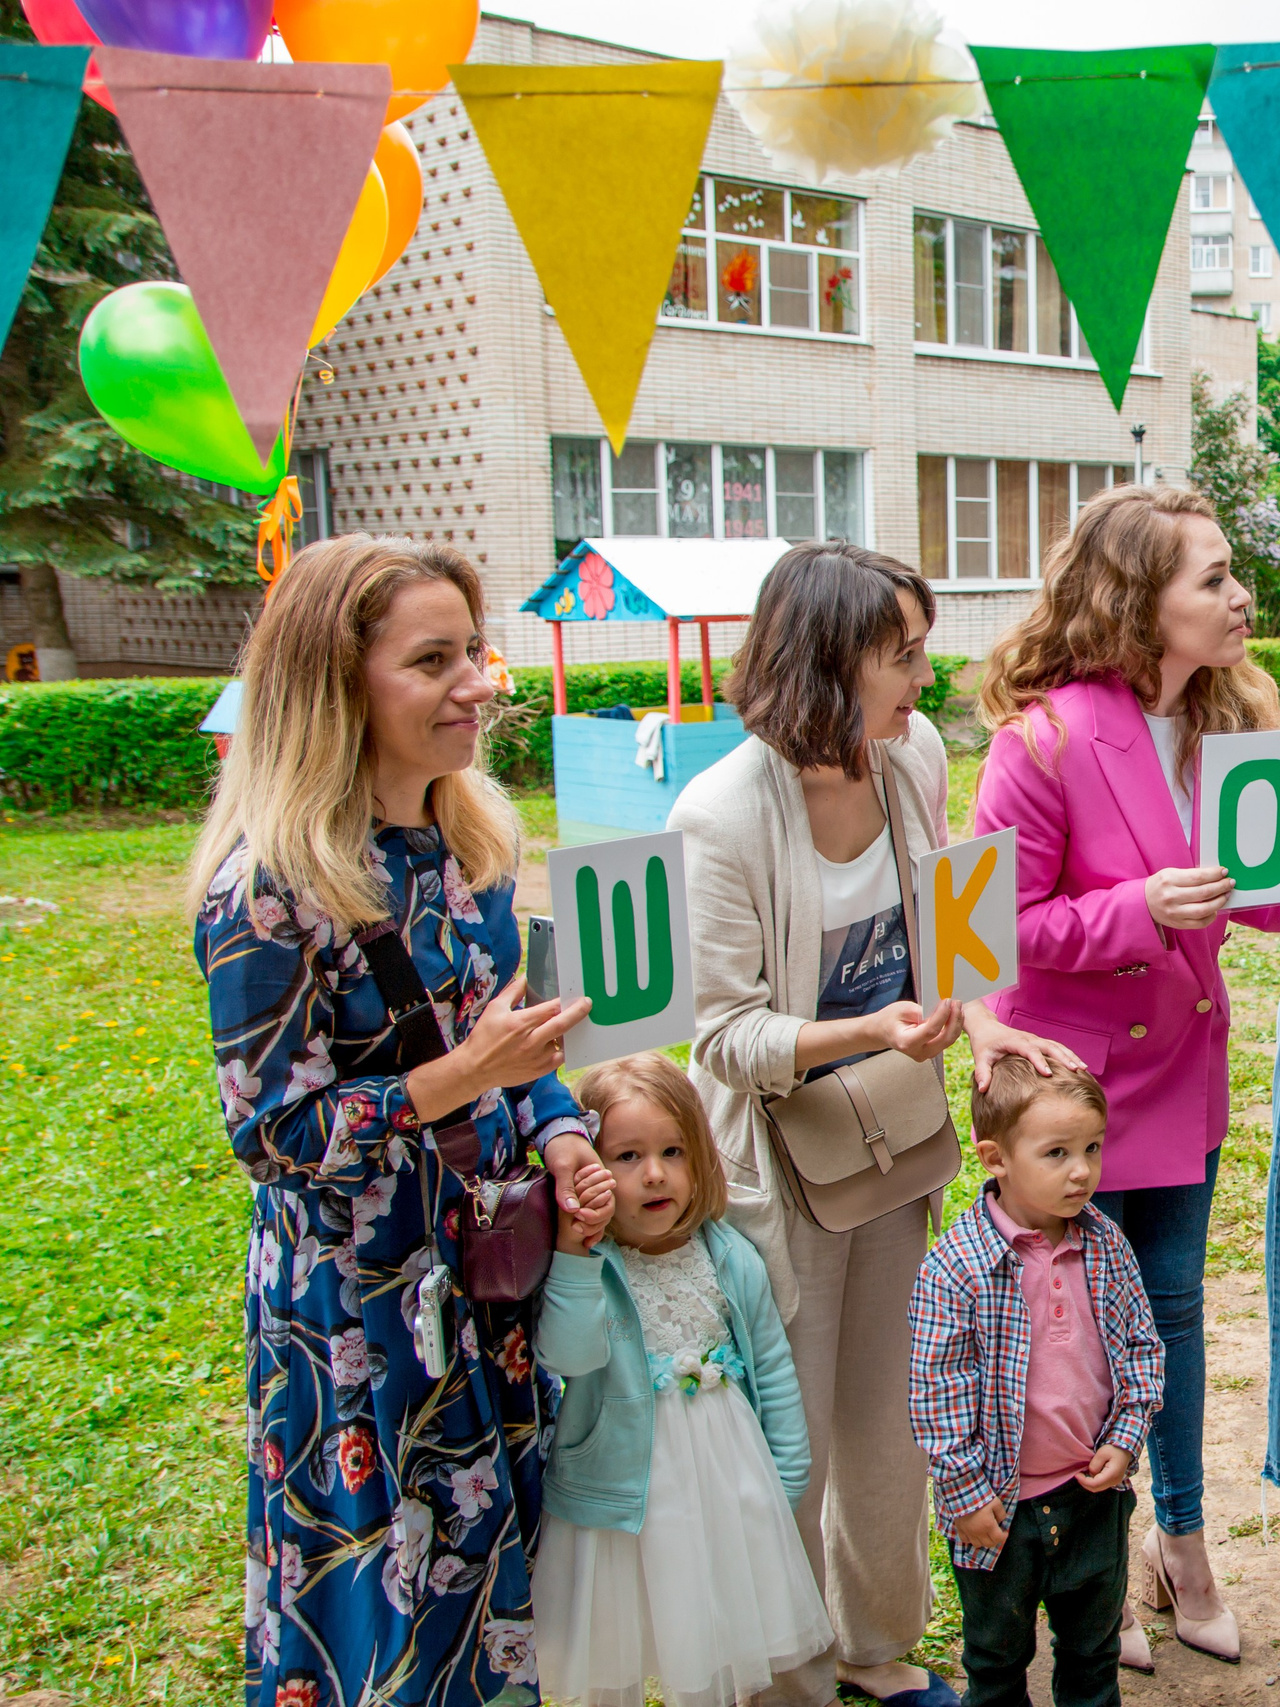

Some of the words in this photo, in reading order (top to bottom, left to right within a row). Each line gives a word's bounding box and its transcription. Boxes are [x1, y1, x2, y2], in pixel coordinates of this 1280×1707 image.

[681, 480, 695, 500] 9
[724, 482, 762, 502] 1941
[725, 519, 764, 538] 1945
[576, 856, 673, 1026] Ш
